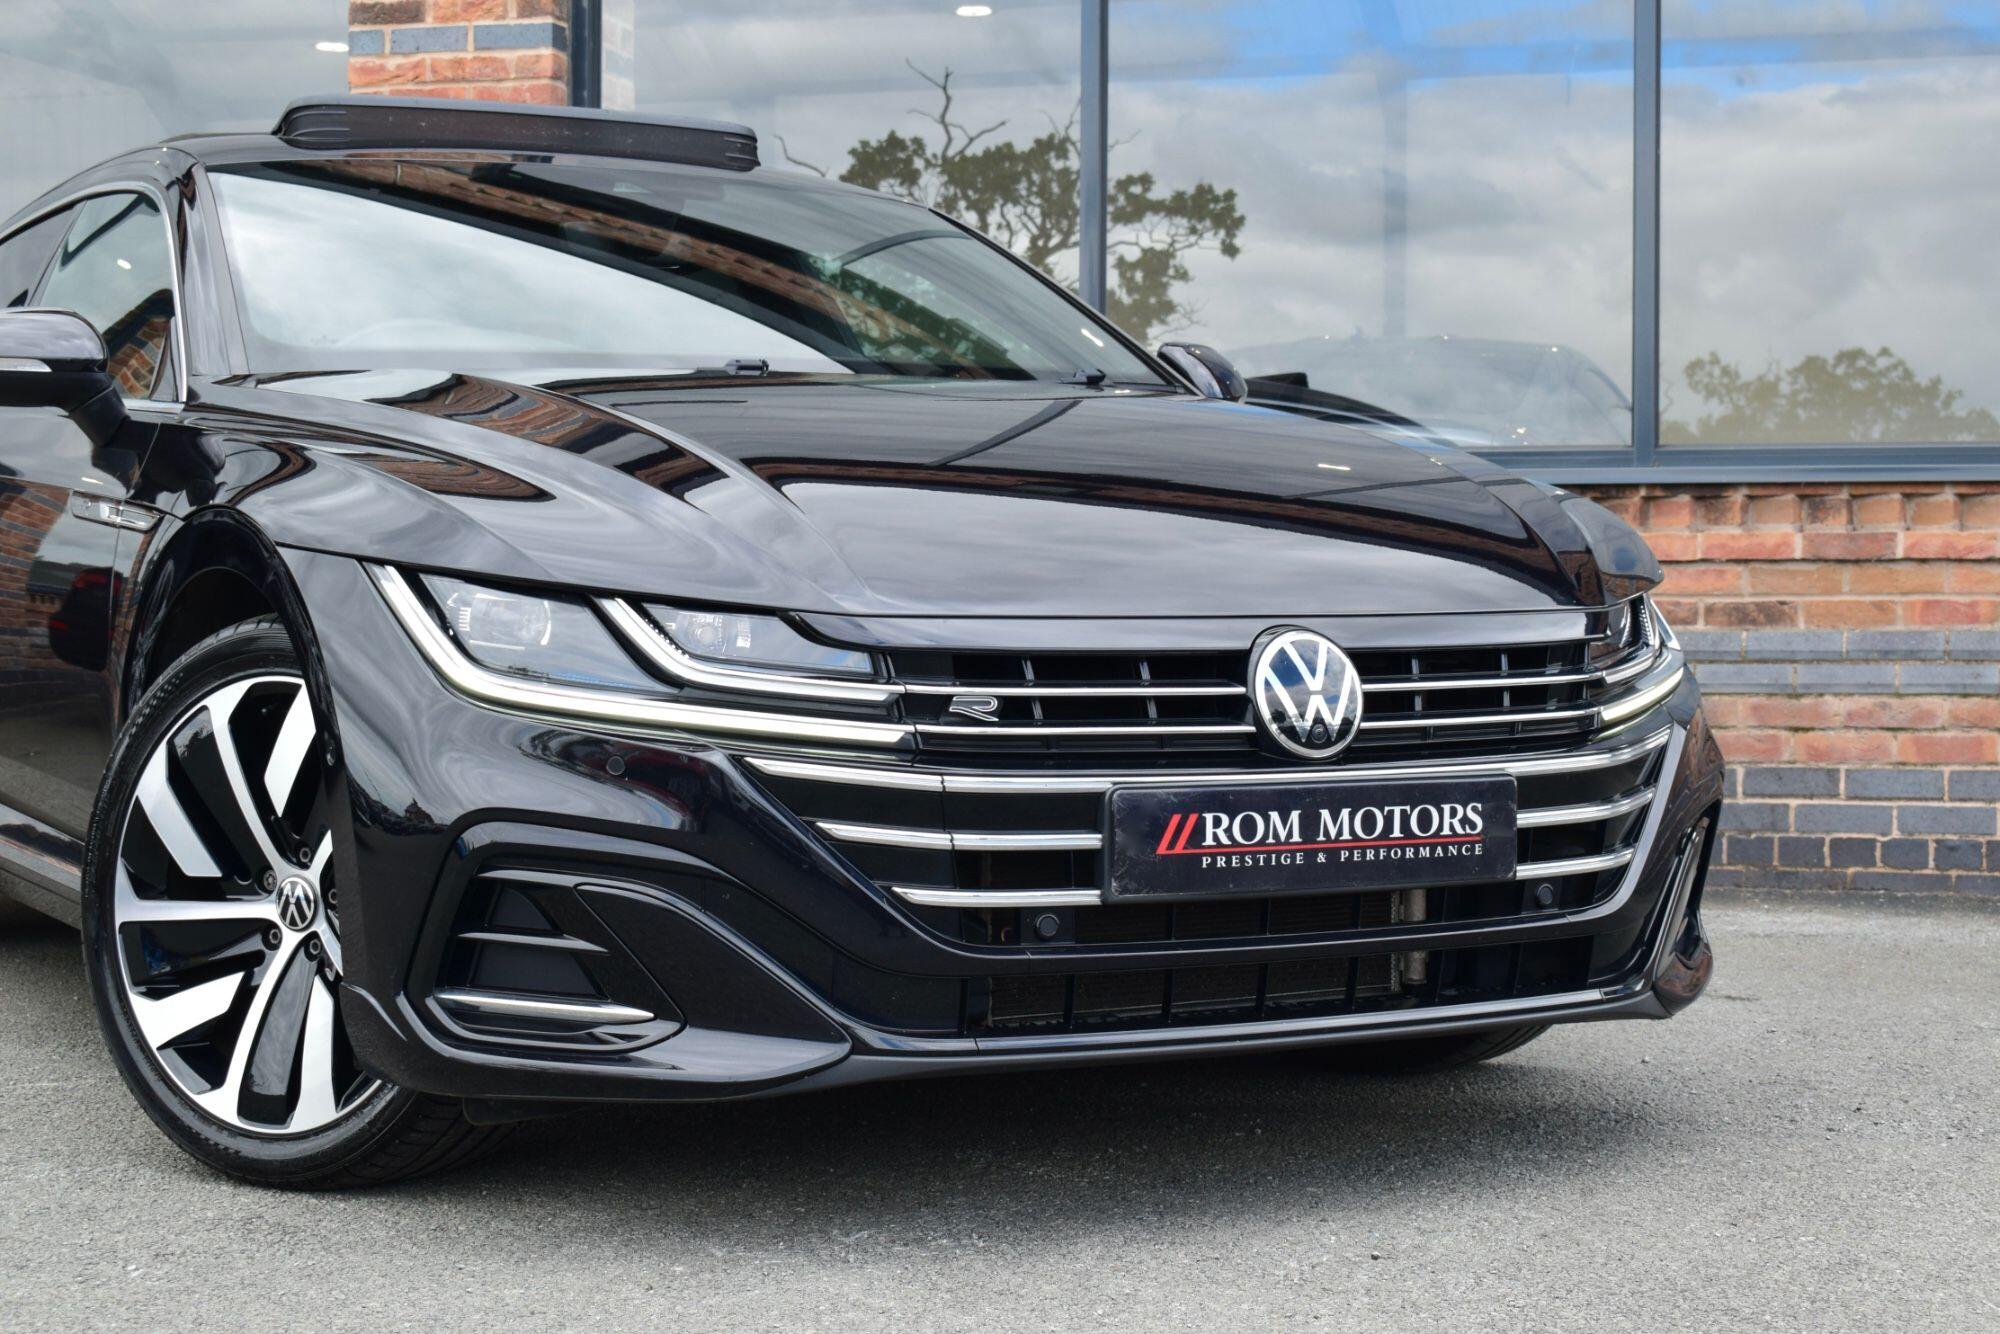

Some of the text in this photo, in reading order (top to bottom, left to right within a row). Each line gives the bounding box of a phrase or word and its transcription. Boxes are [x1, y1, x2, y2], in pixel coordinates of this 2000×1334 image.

[949, 695, 999, 721] R
[1201, 802, 1484, 846] ROM MOTORS
[1201, 843, 1483, 869] PRESTIGE & PERFORMANCE
